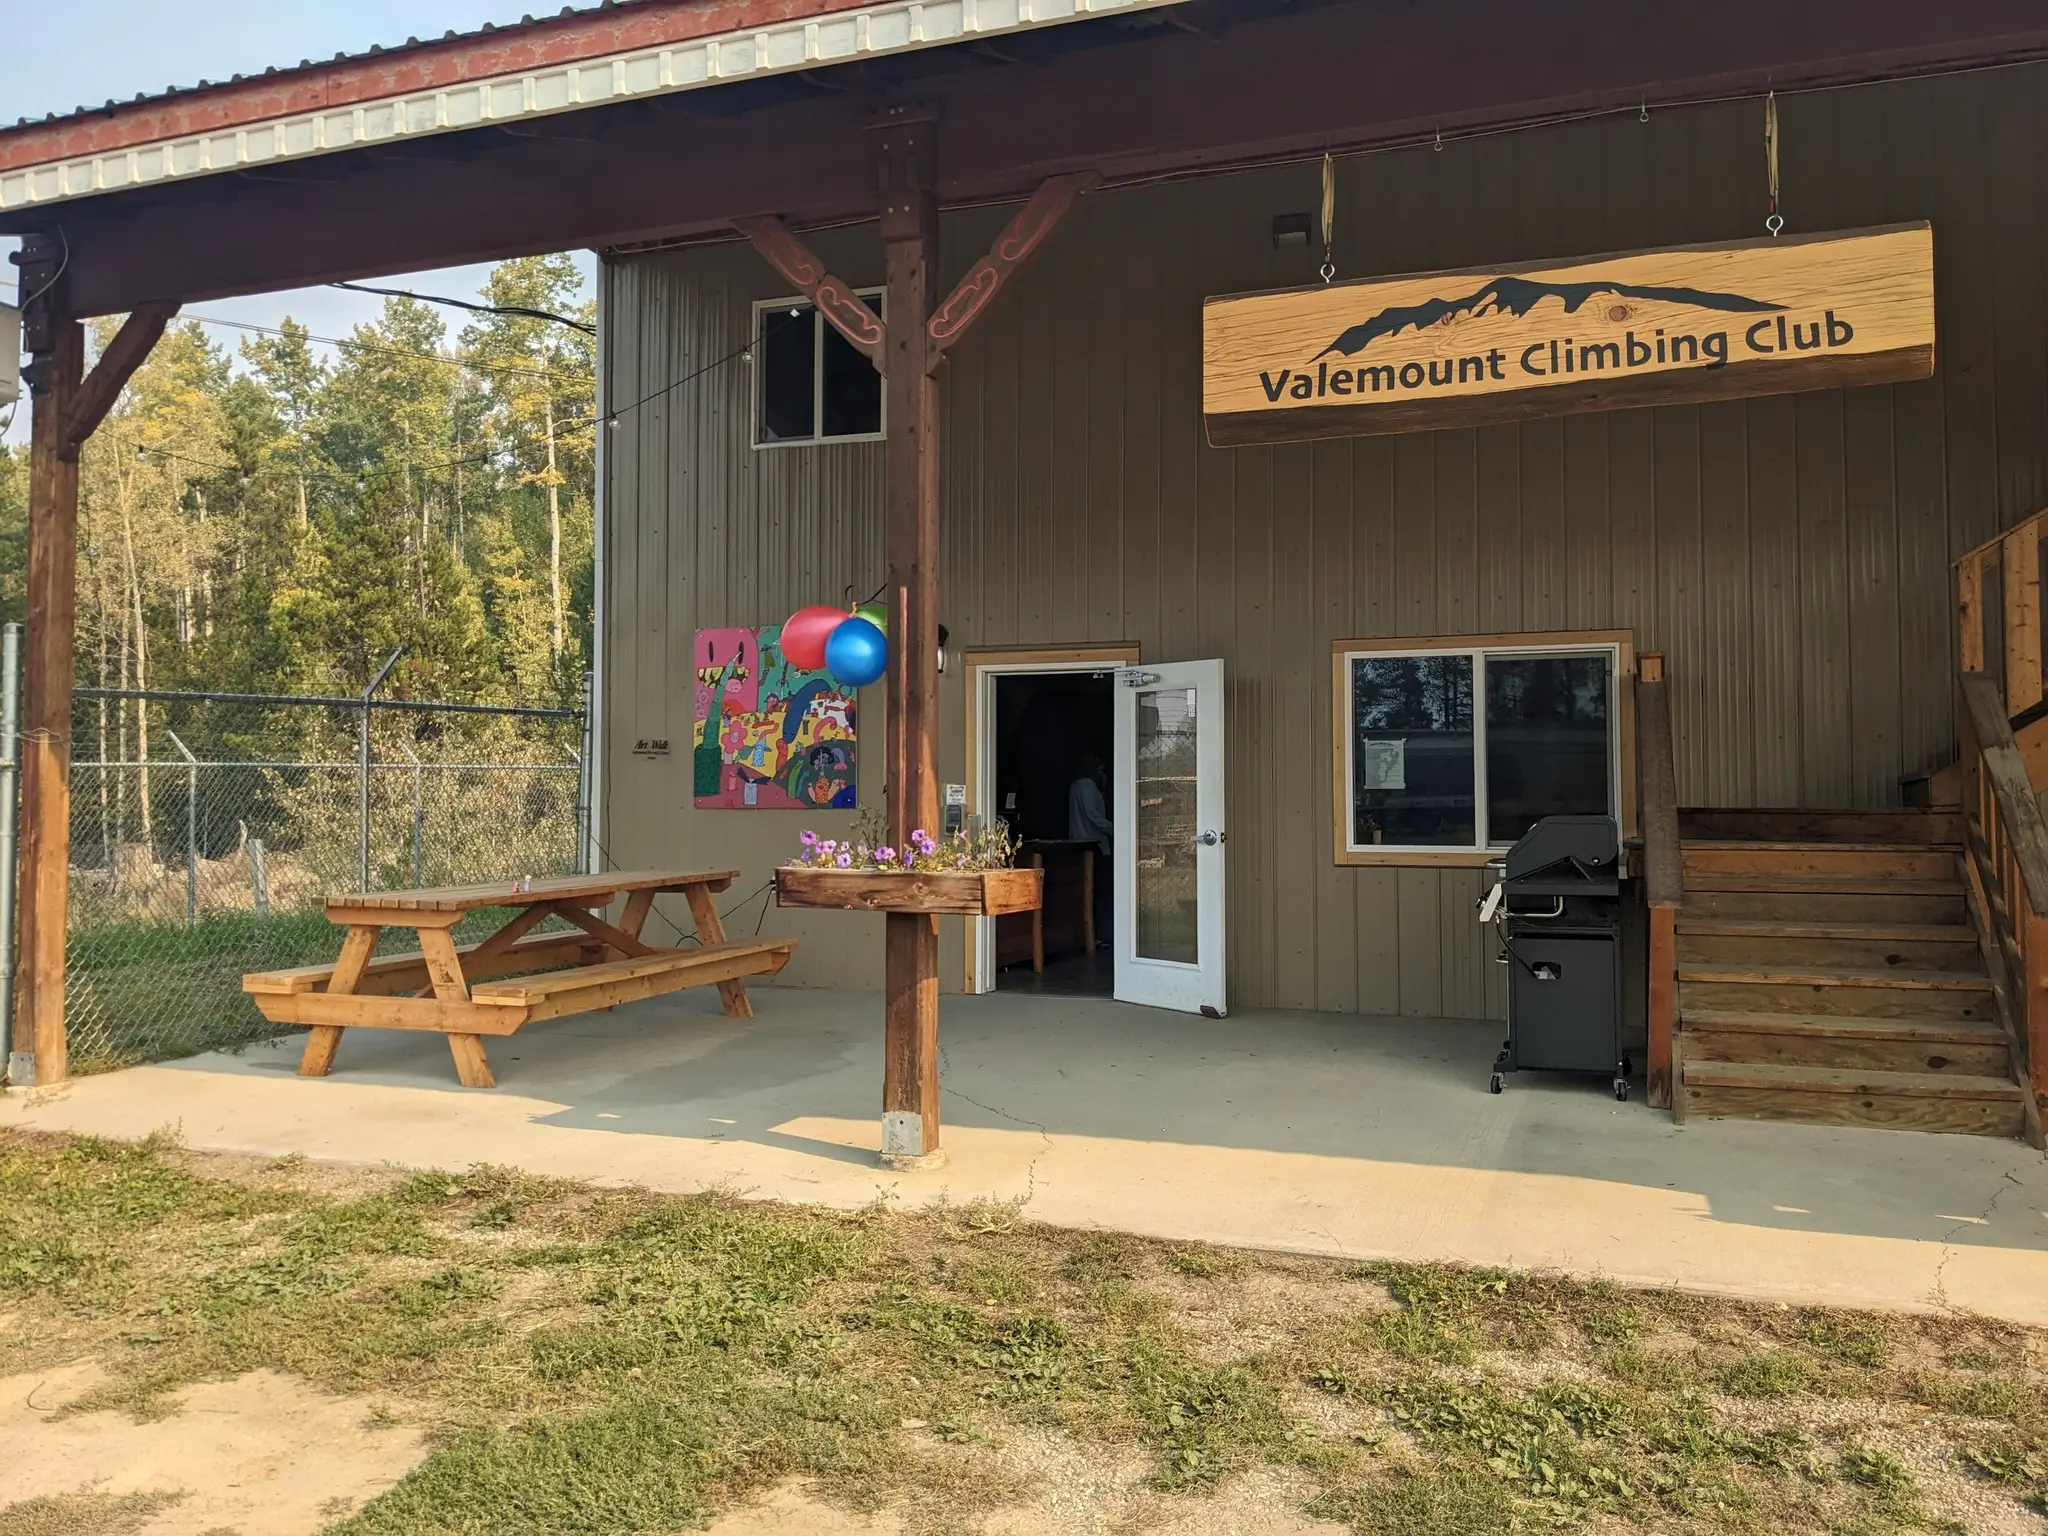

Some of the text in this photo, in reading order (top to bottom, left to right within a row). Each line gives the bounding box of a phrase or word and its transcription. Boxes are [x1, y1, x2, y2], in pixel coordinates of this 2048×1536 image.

[1259, 311, 1854, 402] Valemount Climbing Club
[633, 739, 648, 750] Art
